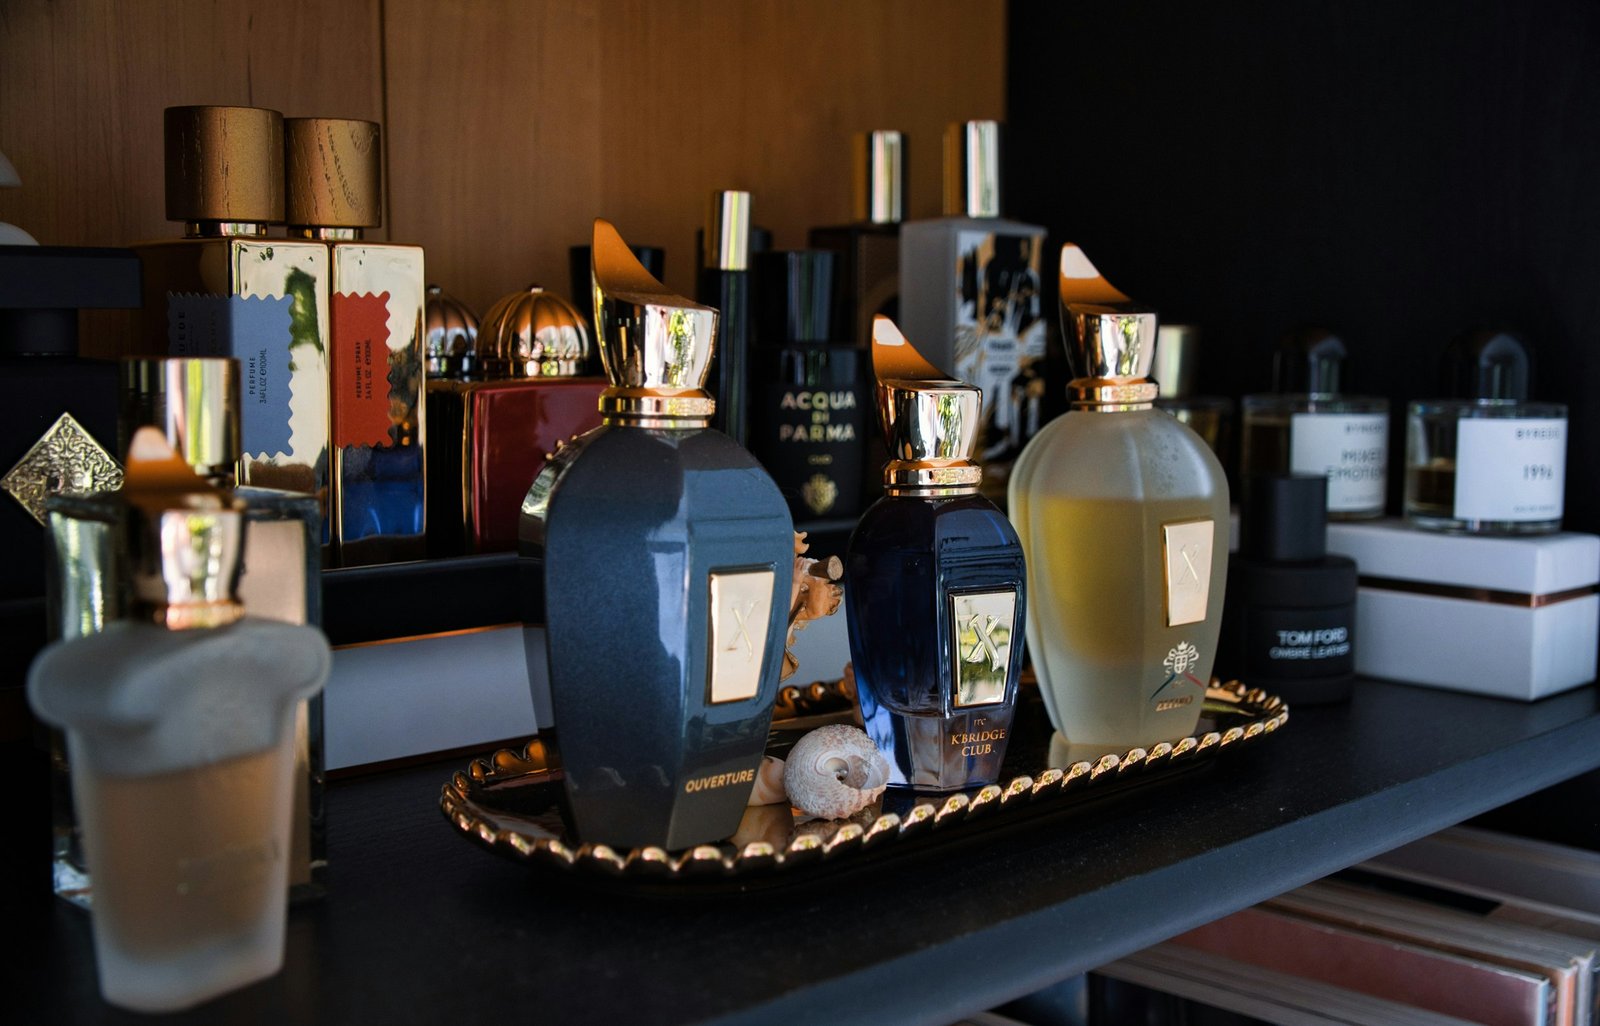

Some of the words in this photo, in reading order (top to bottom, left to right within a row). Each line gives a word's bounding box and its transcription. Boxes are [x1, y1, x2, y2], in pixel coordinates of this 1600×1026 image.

[780, 391, 857, 411] ACQUA
[779, 423, 856, 442] PARMA
[1277, 630, 1313, 646] TOM
[1314, 626, 1348, 645] FORD
[951, 728, 1006, 745] K'BRIDGE
[961, 743, 992, 757] CLUB
[685, 769, 756, 793] OUVERTURE
